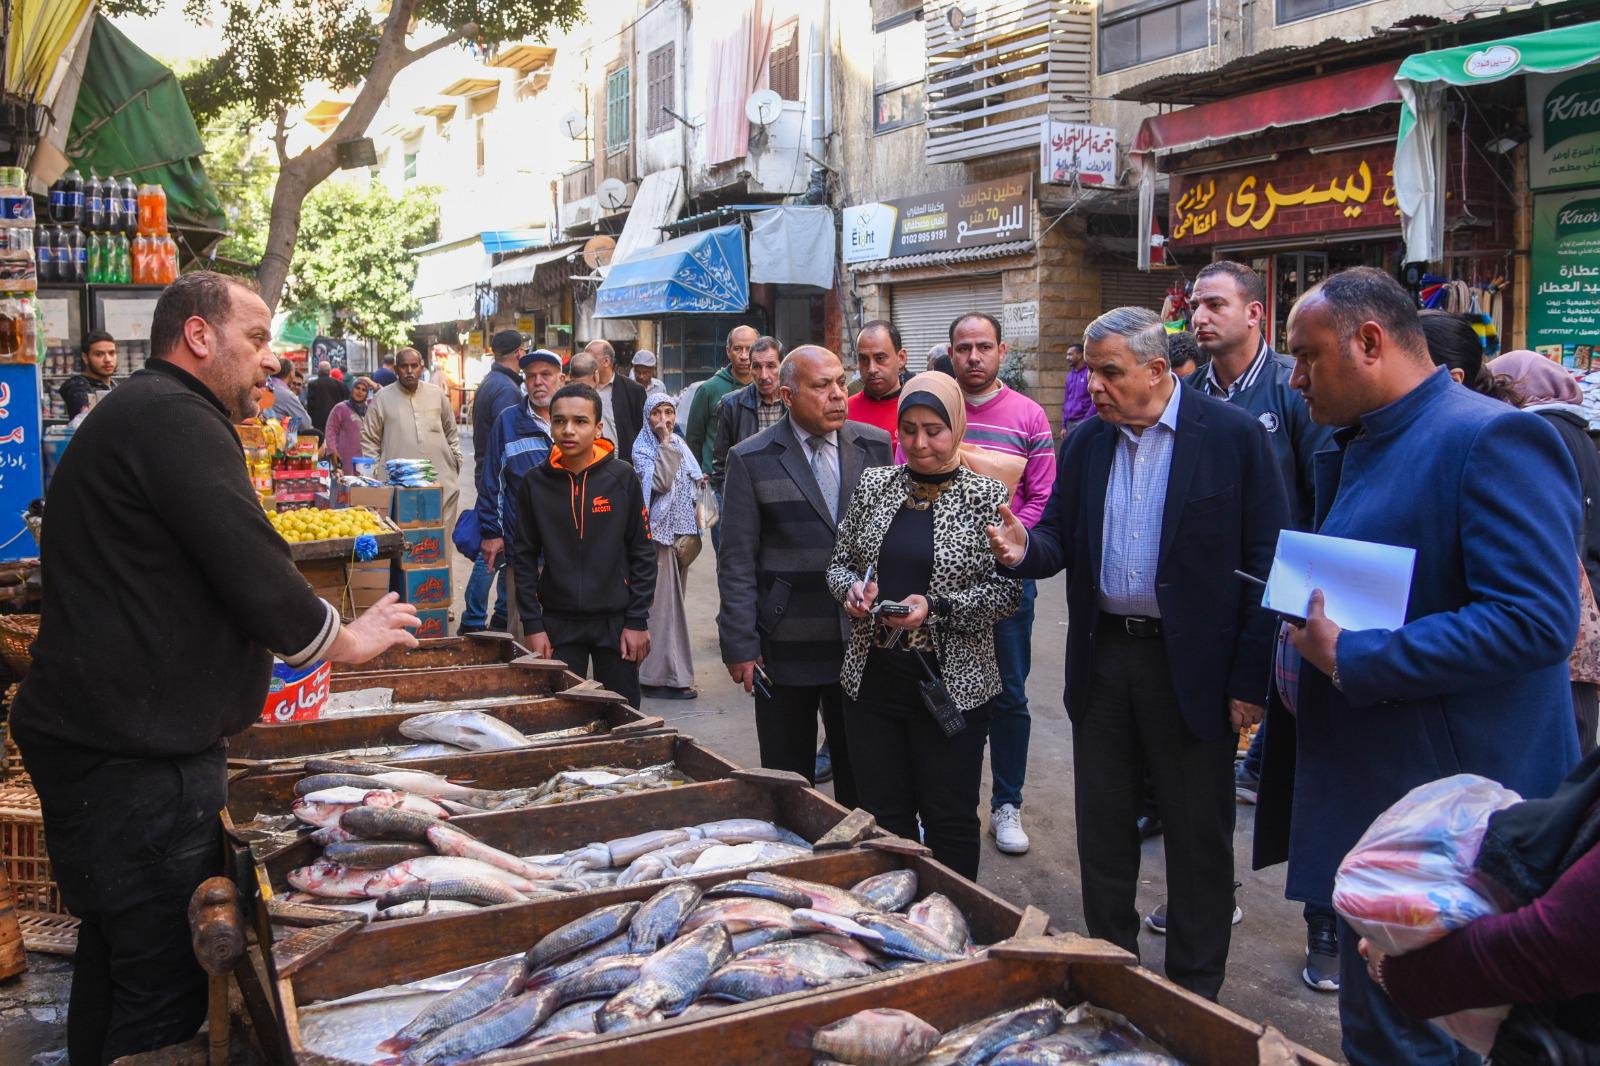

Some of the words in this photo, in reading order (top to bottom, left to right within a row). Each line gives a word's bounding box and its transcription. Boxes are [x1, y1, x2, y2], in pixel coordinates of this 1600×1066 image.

[1546, 92, 1600, 122] Kno
[993, 183, 1024, 202] محلين
[968, 210, 985, 228] متر
[986, 207, 999, 221] 70
[1559, 209, 1600, 225] Knor
[957, 204, 1023, 244] للبيع
[1560, 265, 1600, 279] عطارة
[1537, 281, 1580, 295] العطار
